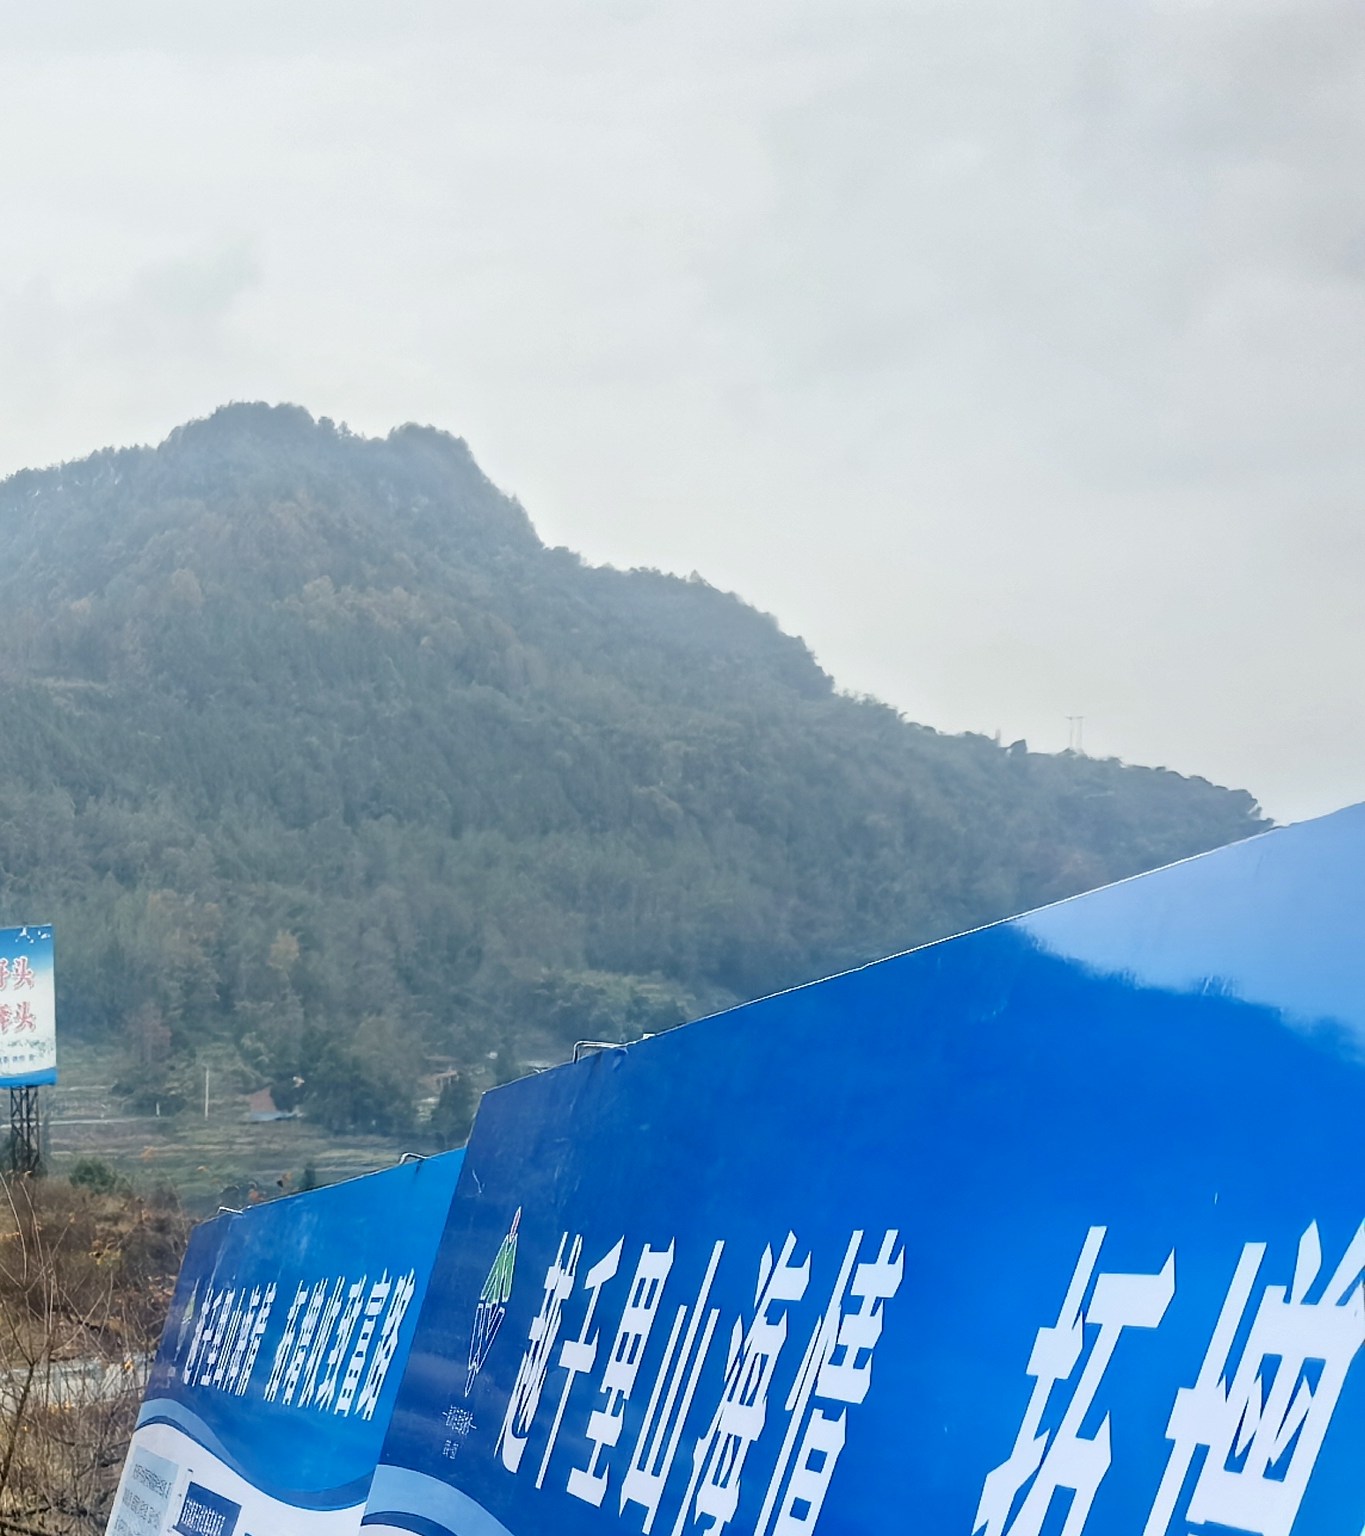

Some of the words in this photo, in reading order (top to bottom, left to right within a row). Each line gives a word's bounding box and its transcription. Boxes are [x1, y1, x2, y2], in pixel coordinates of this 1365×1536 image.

[263, 1268, 415, 1421] 拓增收致富路
